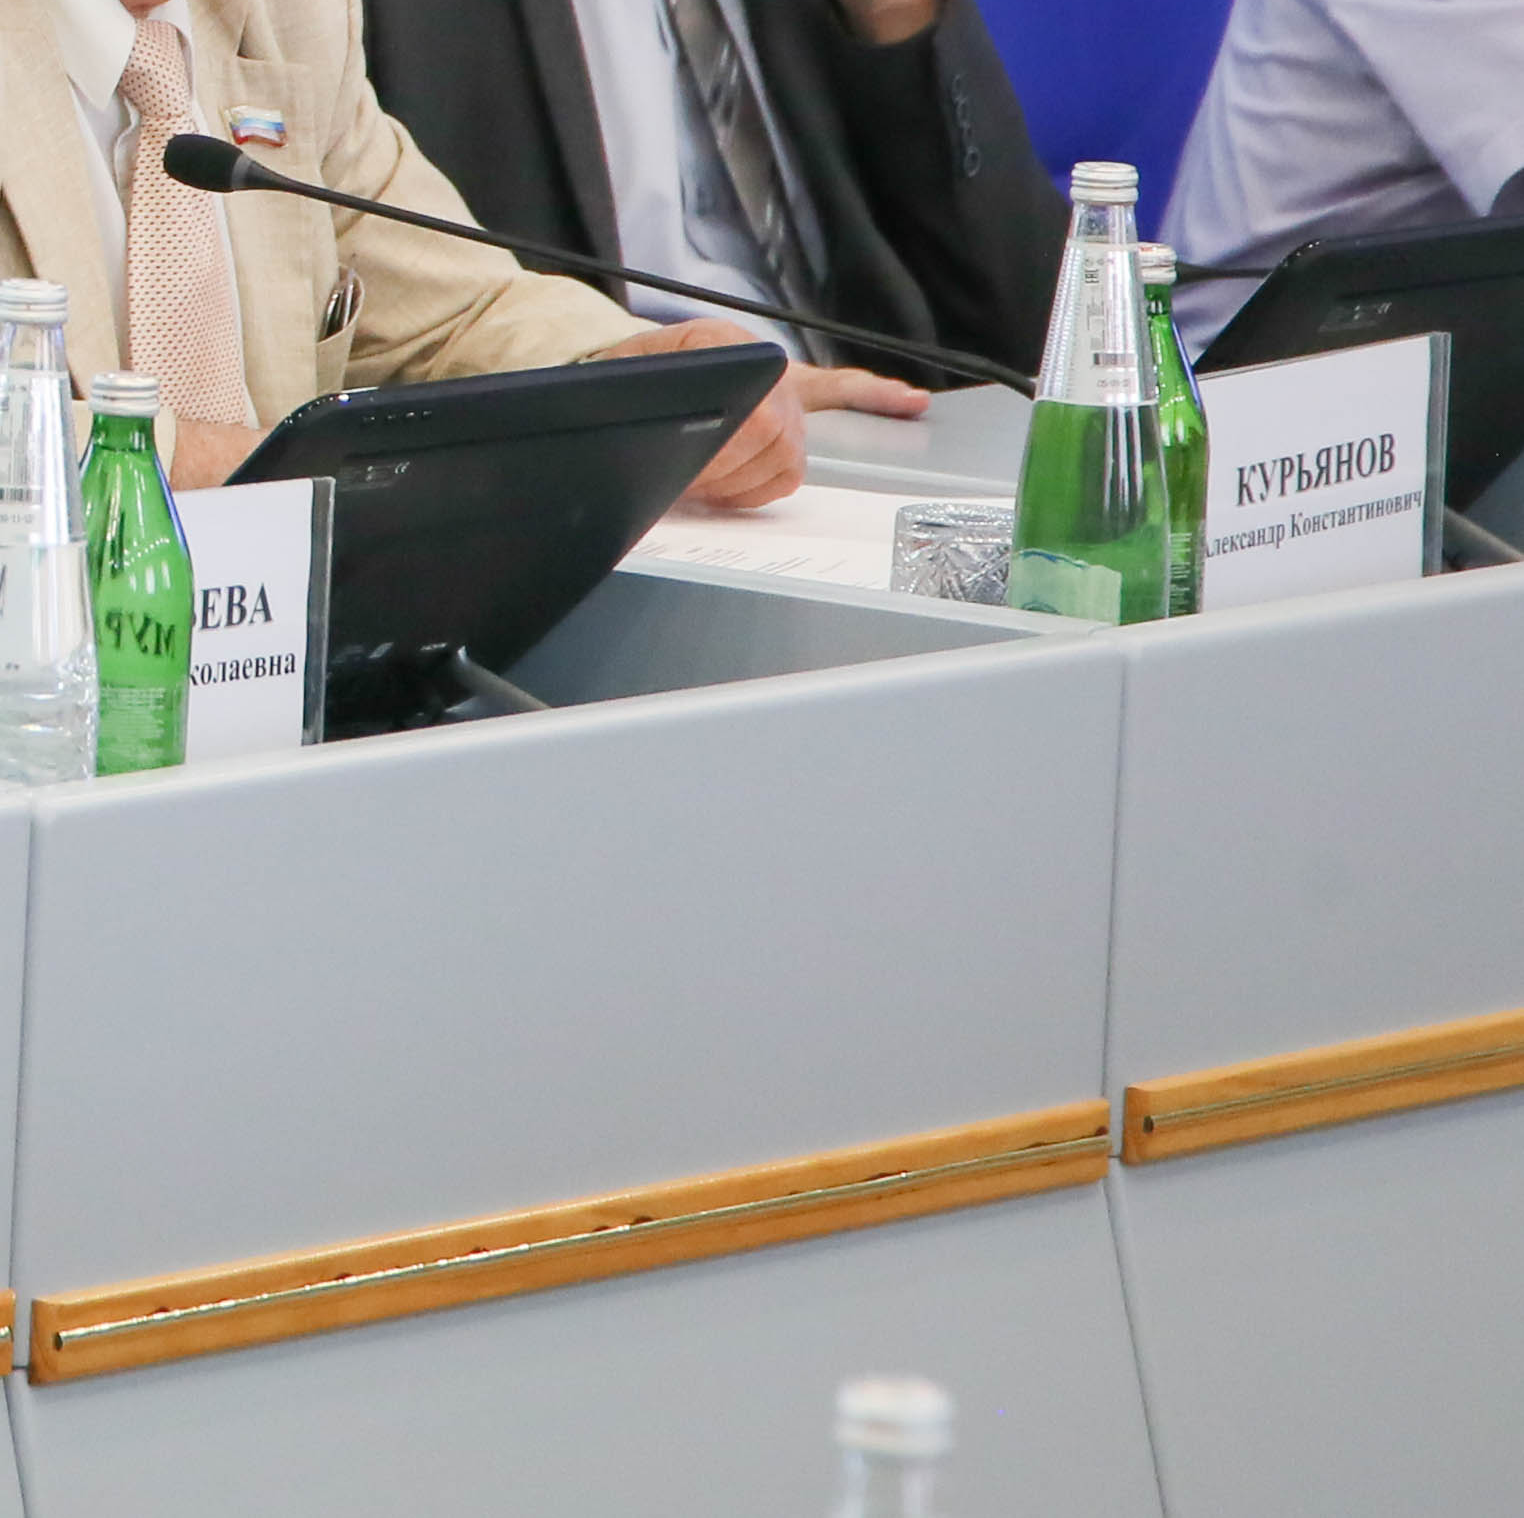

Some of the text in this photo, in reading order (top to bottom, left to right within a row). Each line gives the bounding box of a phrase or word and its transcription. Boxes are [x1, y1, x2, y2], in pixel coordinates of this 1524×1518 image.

[1236, 433, 1395, 507] КУРЬЯНОВ
[1290, 490, 1423, 538] Константинович
[192, 582, 273, 631] ЕВА
